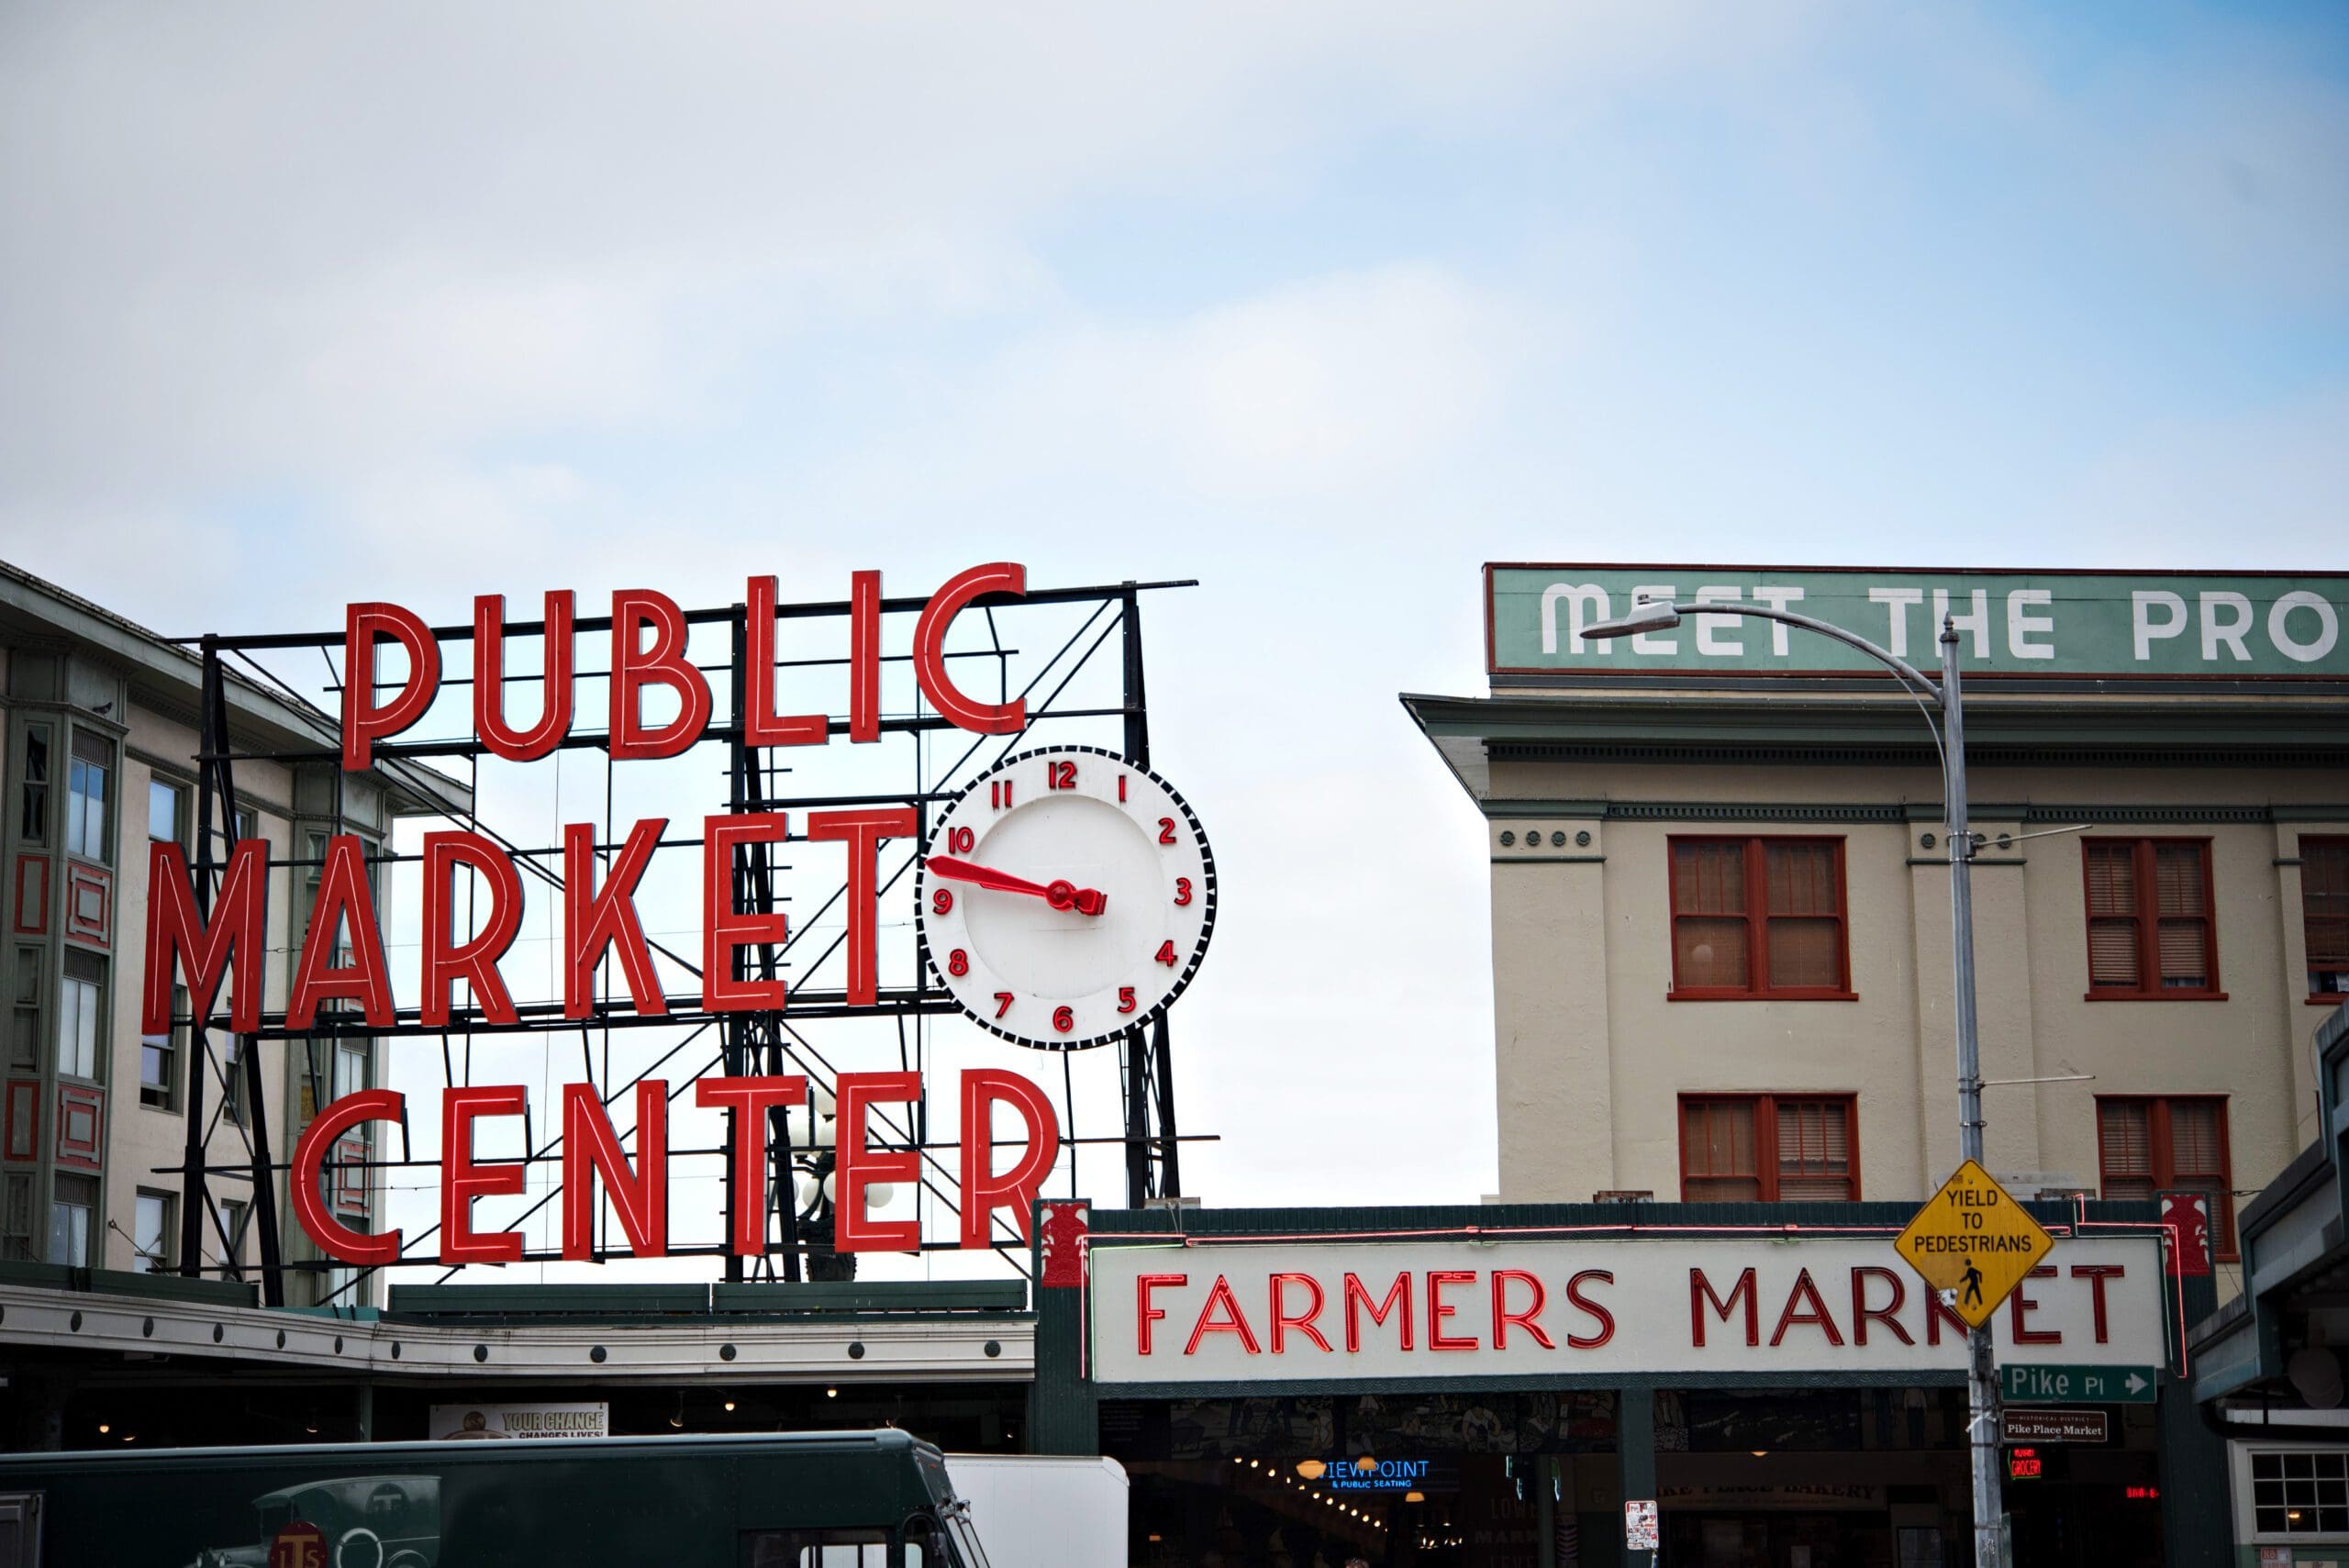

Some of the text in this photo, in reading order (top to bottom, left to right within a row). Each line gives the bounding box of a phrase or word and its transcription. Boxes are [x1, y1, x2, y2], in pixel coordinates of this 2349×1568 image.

[1541, 583, 2339, 662] MEET THE PRO
[342, 562, 1028, 773] PUBLIC
[1048, 761, 1077, 790] 12
[1118, 774, 1128, 803] 1
[991, 780, 1013, 809] 11
[947, 826, 975, 854] 10
[1158, 817, 1177, 844] 2
[932, 888, 953, 916] 9
[1174, 877, 1192, 906] 3
[142, 807, 918, 1036] MARKET
[948, 948, 969, 977] 8
[1153, 939, 1178, 967] 4
[993, 992, 1015, 1018] 7
[1117, 986, 1137, 1014] 5
[1052, 1006, 1074, 1033] 6
[289, 1067, 1063, 1266] CENTER
[1946, 1189, 1998, 1207] YIELD
[1962, 1212, 1983, 1229] TO
[1914, 1235, 2032, 1253] PEDESTRIANS
[1136, 1268, 1616, 1355] FARMERS
[2010, 1367, 2070, 1396] Pike
[502, 1411, 604, 1430] YOUR CHANGE
[2008, 1424, 2102, 1435] Pike Place Market
[1341, 1480, 1371, 1489] PUBLIC
[1374, 1479, 1412, 1488] SEATING
